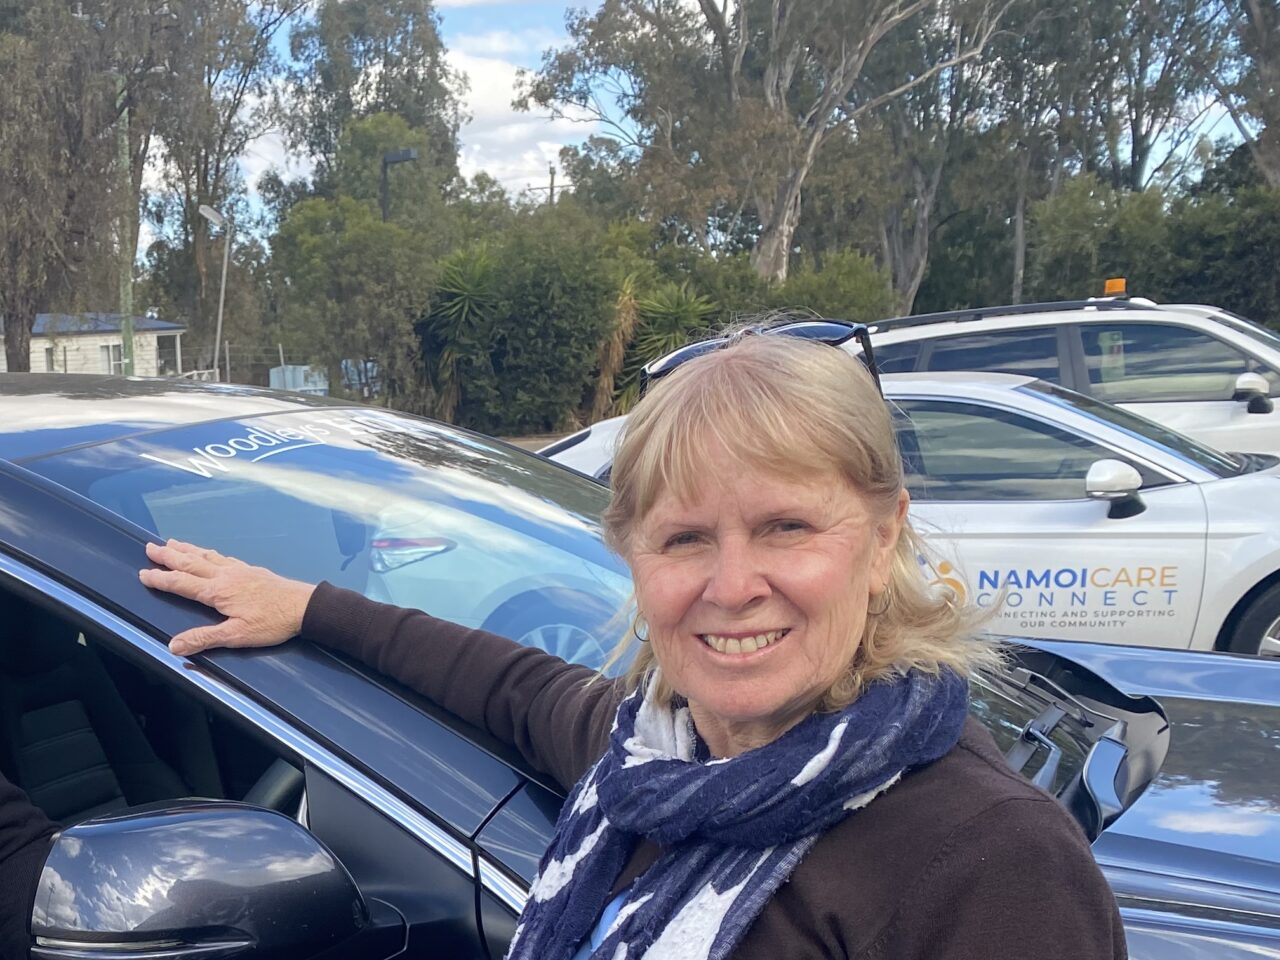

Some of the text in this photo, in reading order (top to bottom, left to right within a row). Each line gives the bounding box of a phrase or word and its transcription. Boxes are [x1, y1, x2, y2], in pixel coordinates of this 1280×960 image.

[139, 423, 331, 479] Woodleys
[979, 566, 1179, 589] NAMOICARE
[976, 590, 1179, 607] CONNECT
[993, 609, 1176, 619] NNECTING AND SUPPORTING
[1019, 619, 1127, 629] OUR COMMUNITY
